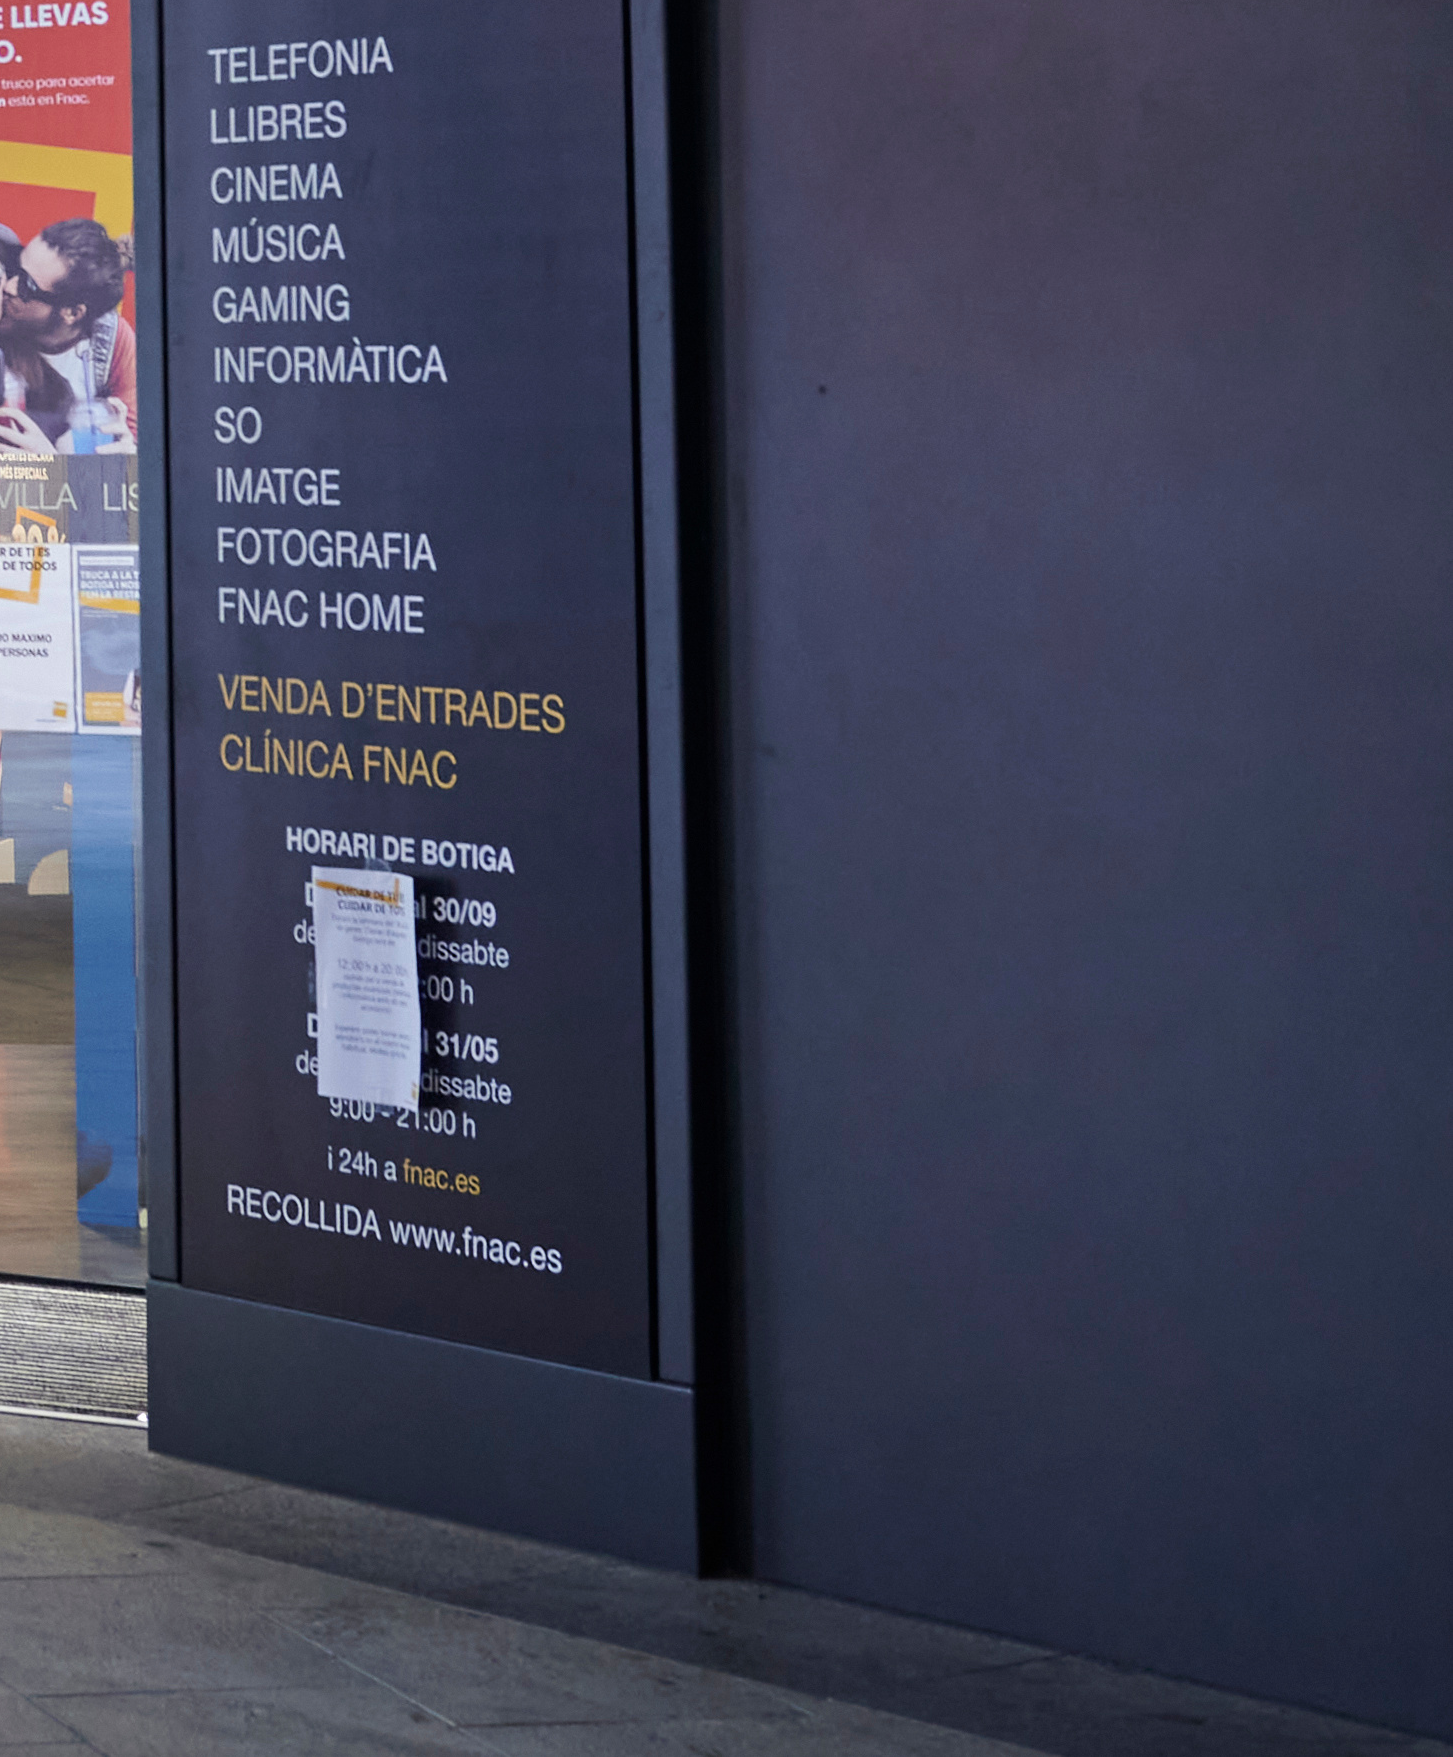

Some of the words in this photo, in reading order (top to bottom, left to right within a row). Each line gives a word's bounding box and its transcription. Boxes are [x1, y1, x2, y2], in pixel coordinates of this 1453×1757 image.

[10, 1, 109, 28] LLEVAS
[207, 36, 393, 84] TELEFONIA
[1, 78, 33, 90] truco
[36, 79, 66, 92] para
[68, 74, 114, 87] acertar
[37, 95, 53, 105] en
[56, 93, 89, 104] Fnac.
[210, 100, 347, 144] LLIBRES
[210, 162, 343, 204] CINEMA
[212, 217, 346, 263] MÚSICA
[213, 285, 350, 324] GAMING
[214, 337, 448, 384] INFORMÀTICA
[214, 407, 262, 444] SO
[216, 467, 340, 506] IMATGE
[3, 562, 16, 571] DE
[20, 562, 57, 571] TODOS
[10, 548, 22, 557] DE
[40, 548, 50, 557] ES
[217, 527, 437, 571] FOTOGRAFIA
[218, 587, 309, 625] FNAC
[321, 592, 424, 634] HOME
[12, 634, 52, 643] MAXIMO
[218, 673, 332, 718] VENDA
[342, 682, 566, 733] D'ENTRADES
[220, 729, 353, 781] CLÍNICA
[364, 745, 458, 790] FNAC
[286, 826, 377, 858] HORARI
[383, 837, 415, 864] DE
[421, 839, 515, 874] BOTIGA
[433, 897, 497, 928] 30/09
[418, 934, 509, 969] dissabte
[460, 980, 474, 1006] h
[435, 1031, 499, 1064] 31/05
[421, 1069, 512, 1106] dissabte
[329, 1098, 375, 1123] 9:00
[396, 1104, 456, 1137] 21:00
[462, 1112, 476, 1140] h
[327, 1146, 333, 1170] i
[338, 1148, 378, 1179] 24h
[384, 1159, 397, 1181] a
[403, 1157, 481, 1195] fnac.es
[227, 1183, 381, 1241] RECOLLIDA
[389, 1218, 563, 1274] www.fnac.es
